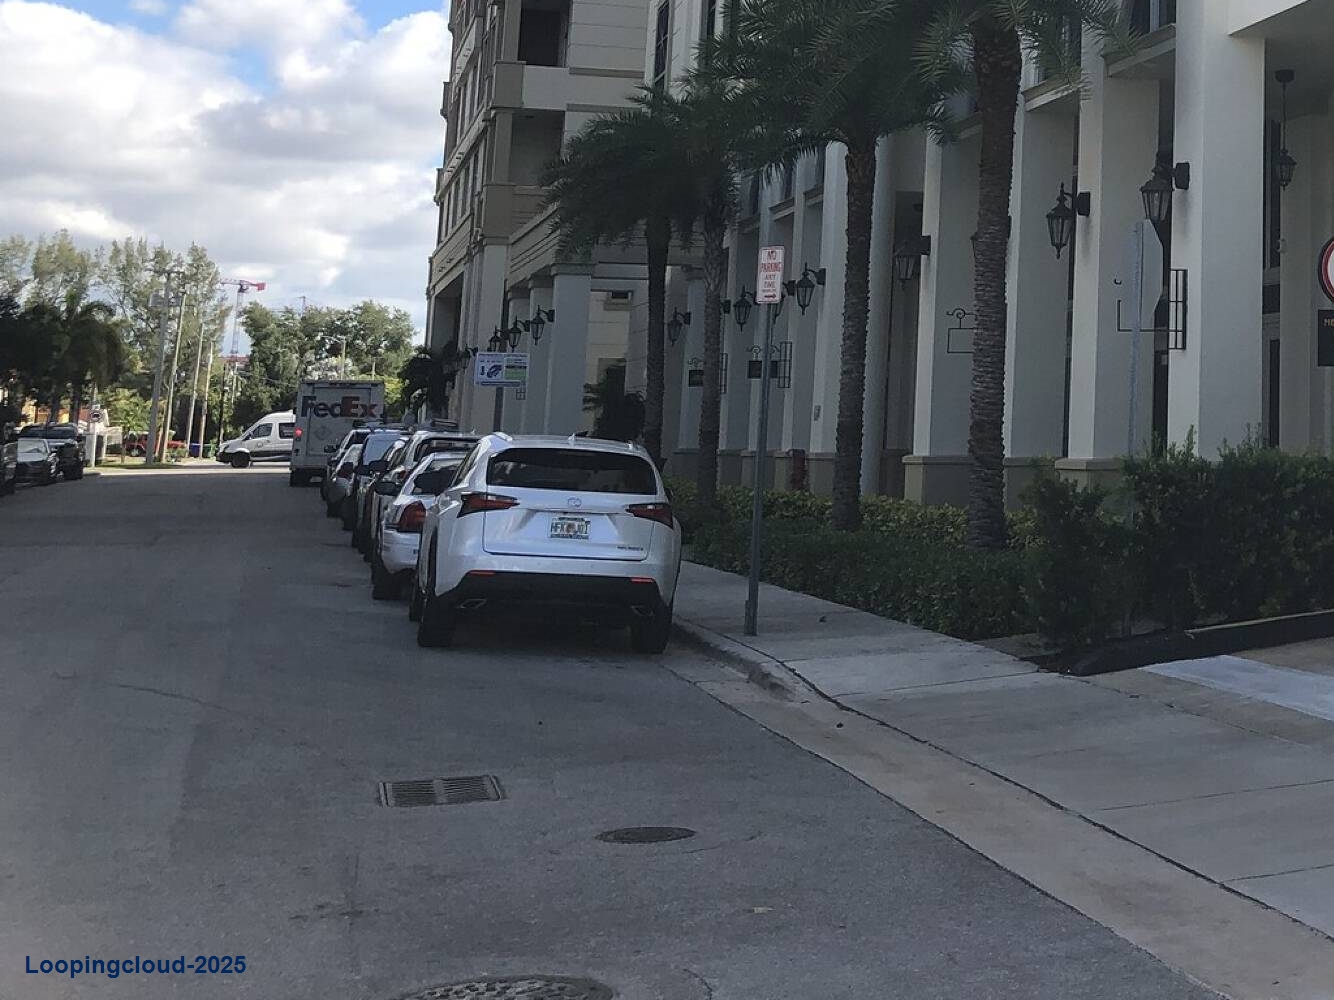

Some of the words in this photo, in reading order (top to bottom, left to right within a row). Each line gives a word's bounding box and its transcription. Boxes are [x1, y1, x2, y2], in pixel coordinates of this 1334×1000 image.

[767, 250, 777, 260] NO
[761, 263, 782, 272] PARKING
[301, 395, 378, 418] FedEx
